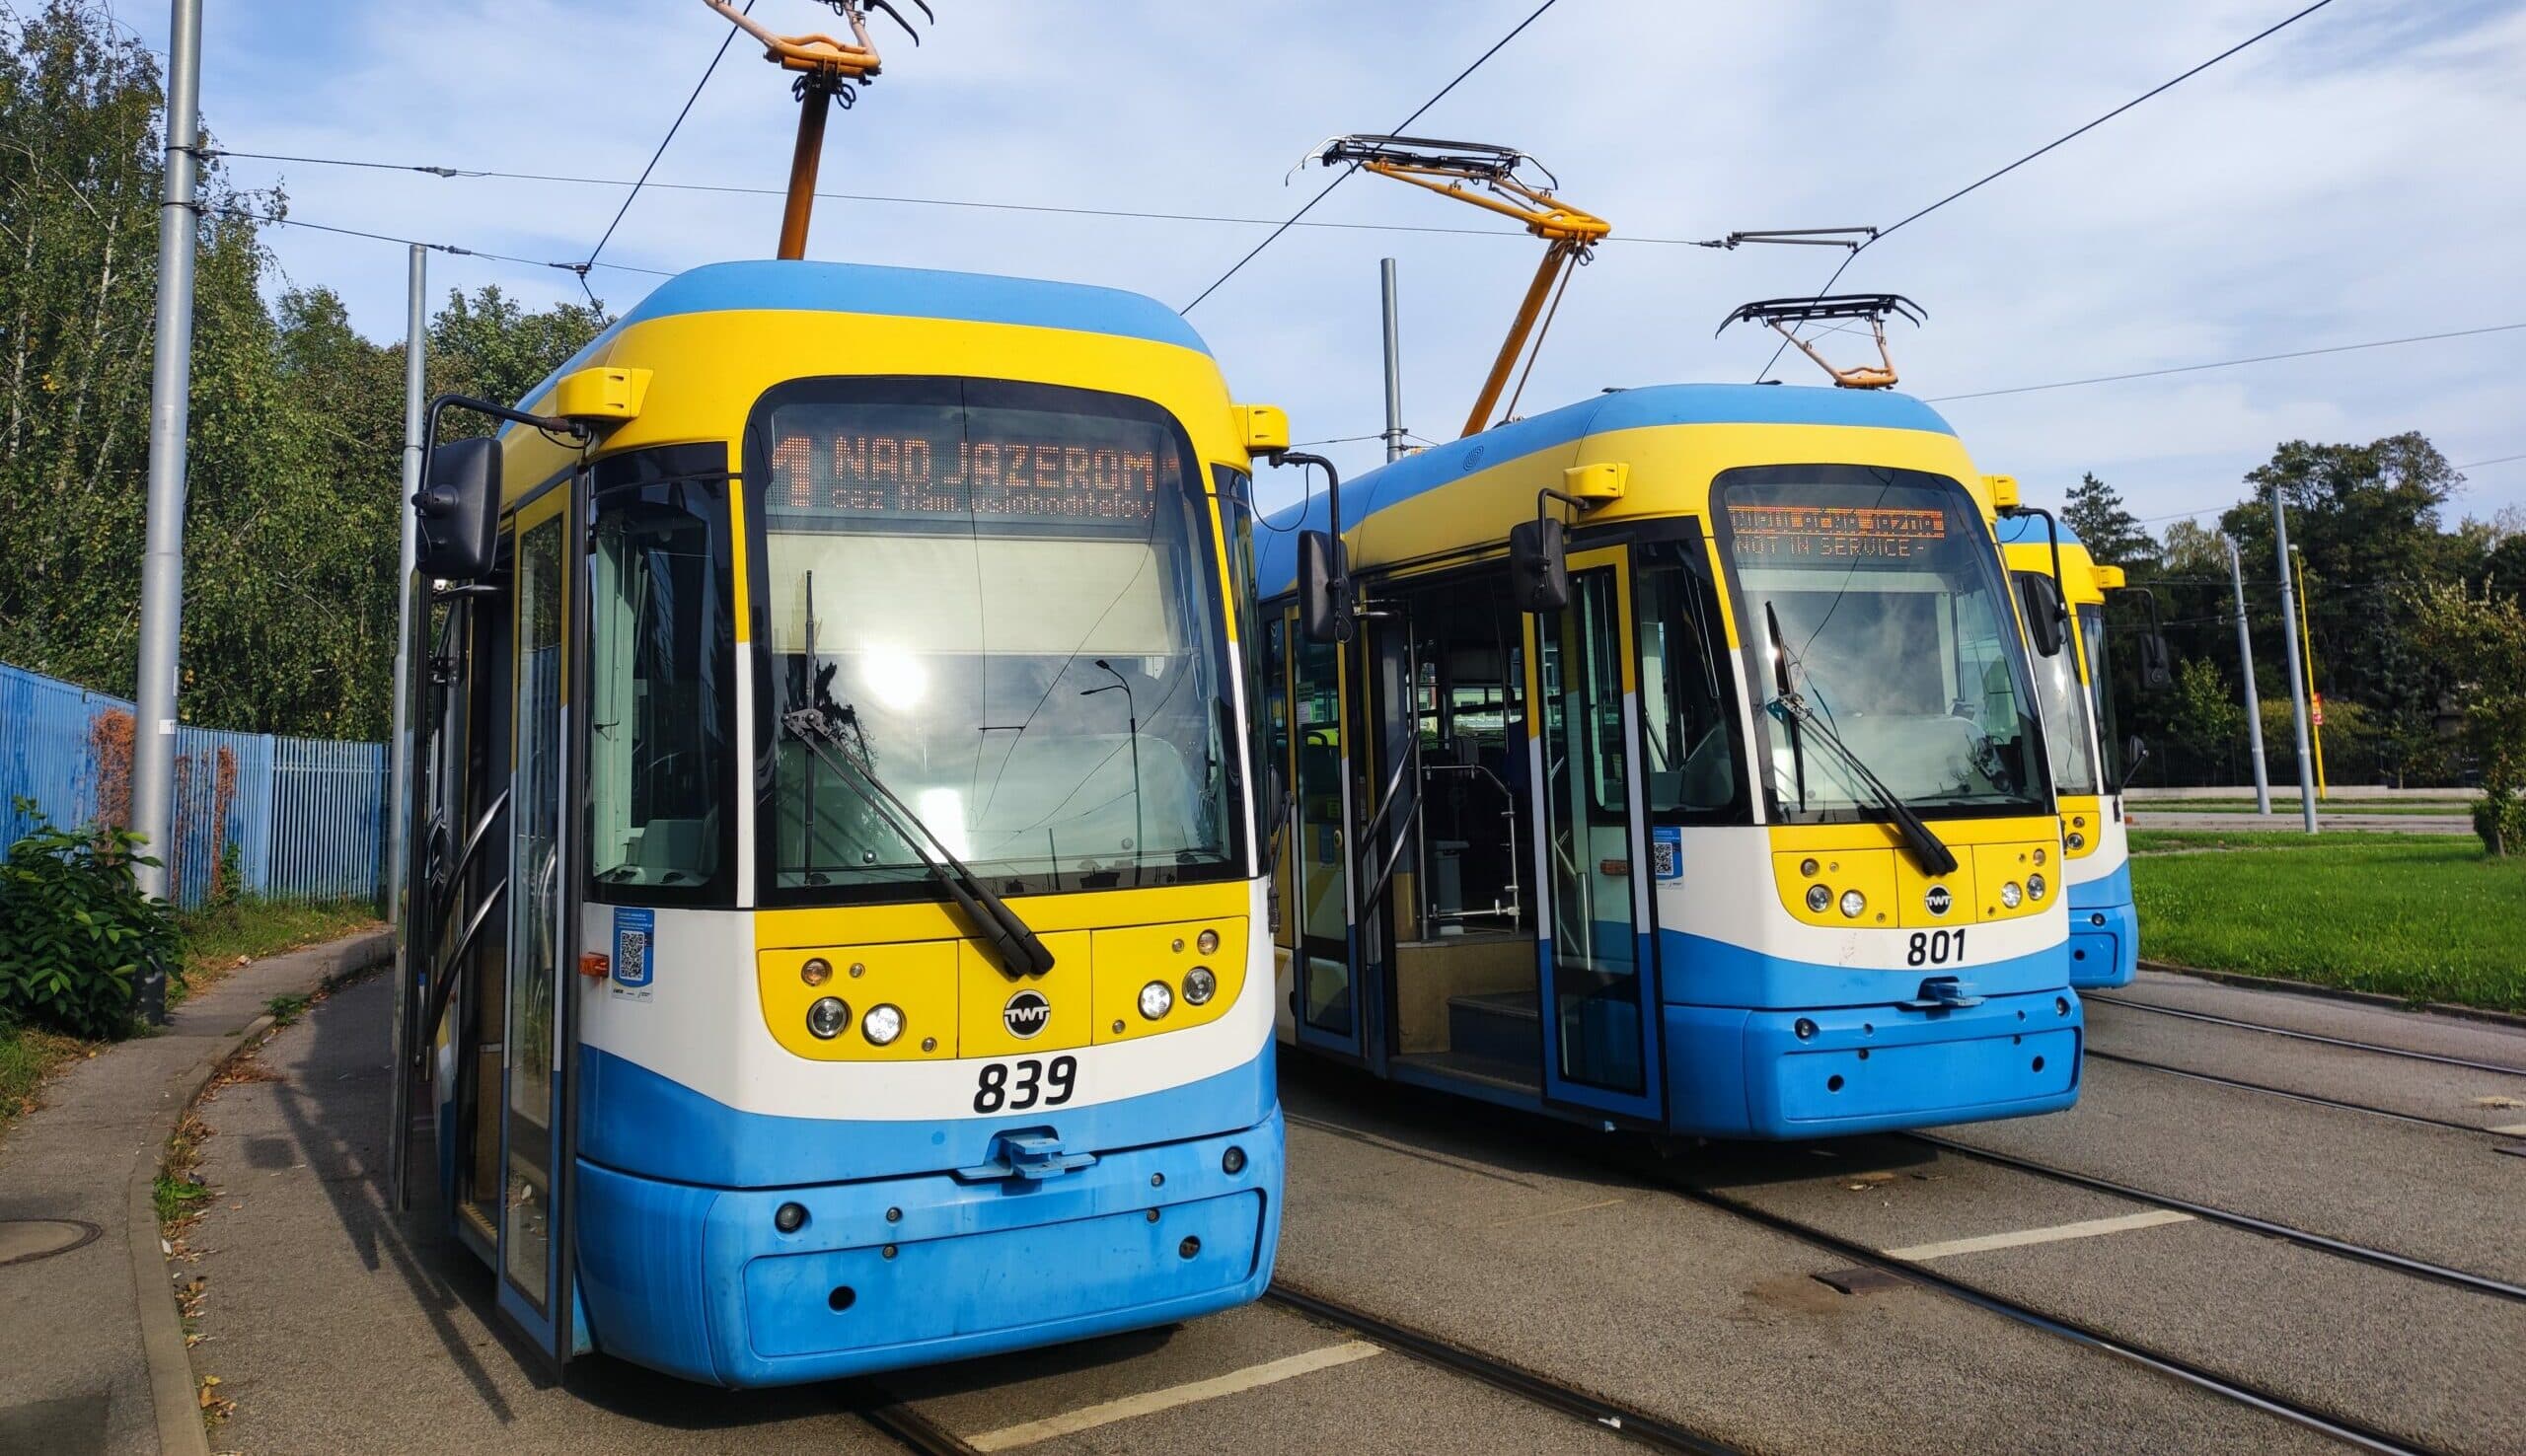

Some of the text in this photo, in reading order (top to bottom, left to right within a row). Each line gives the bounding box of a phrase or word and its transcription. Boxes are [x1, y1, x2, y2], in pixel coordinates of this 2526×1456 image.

[772, 436, 1154, 508] 1 NAD JAZEROM
[1736, 536, 1778, 554] NOT
[1790, 537, 1812, 555] IN
[1820, 537, 1912, 557] SERVICE
[1906, 927, 1967, 967] 801
[972, 1055, 1078, 1115] 839
